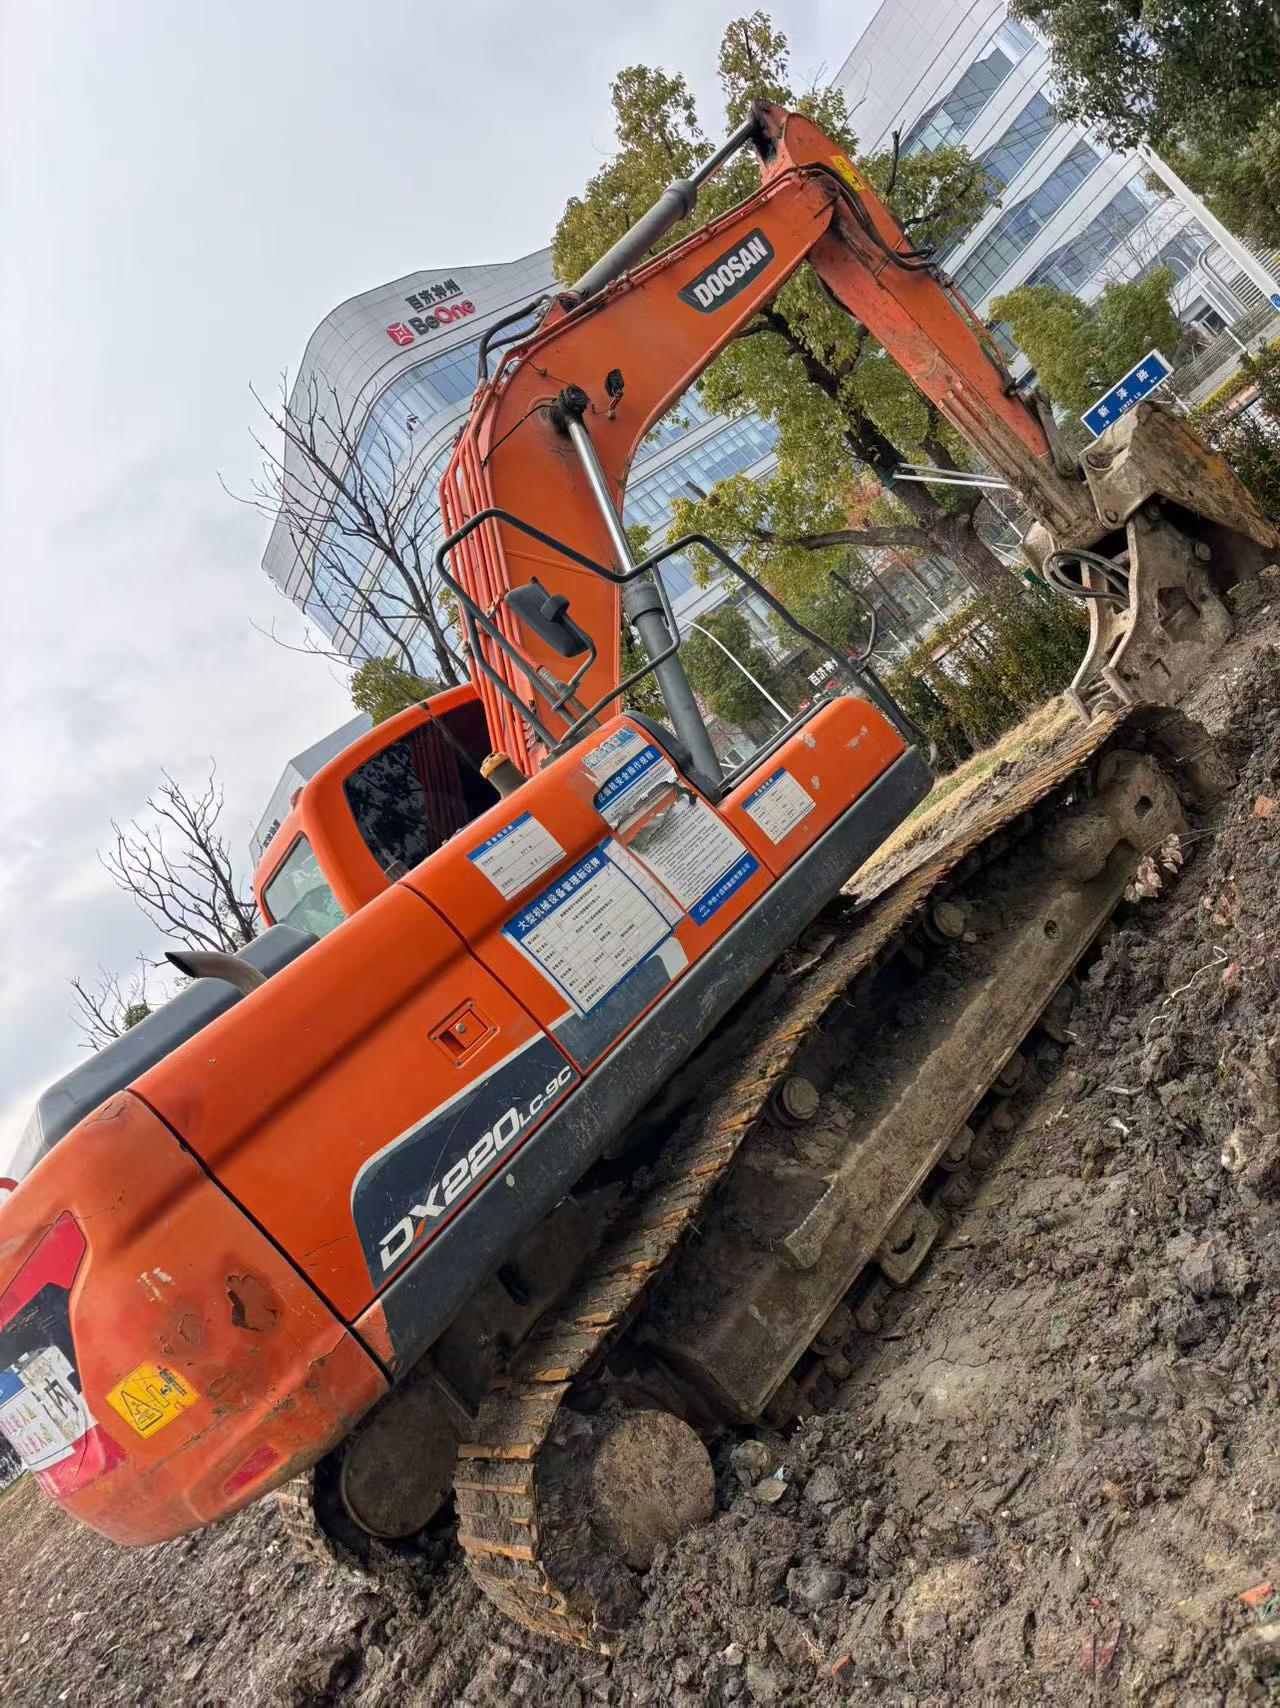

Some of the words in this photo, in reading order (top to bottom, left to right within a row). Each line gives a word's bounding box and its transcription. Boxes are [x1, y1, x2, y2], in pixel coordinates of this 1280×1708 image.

[404, 278, 461, 311] 百济神州
[693, 236, 768, 308] DOOSAN
[408, 300, 476, 335] BeOne
[517, 856, 601, 932] 大型机械设备管理标识牌
